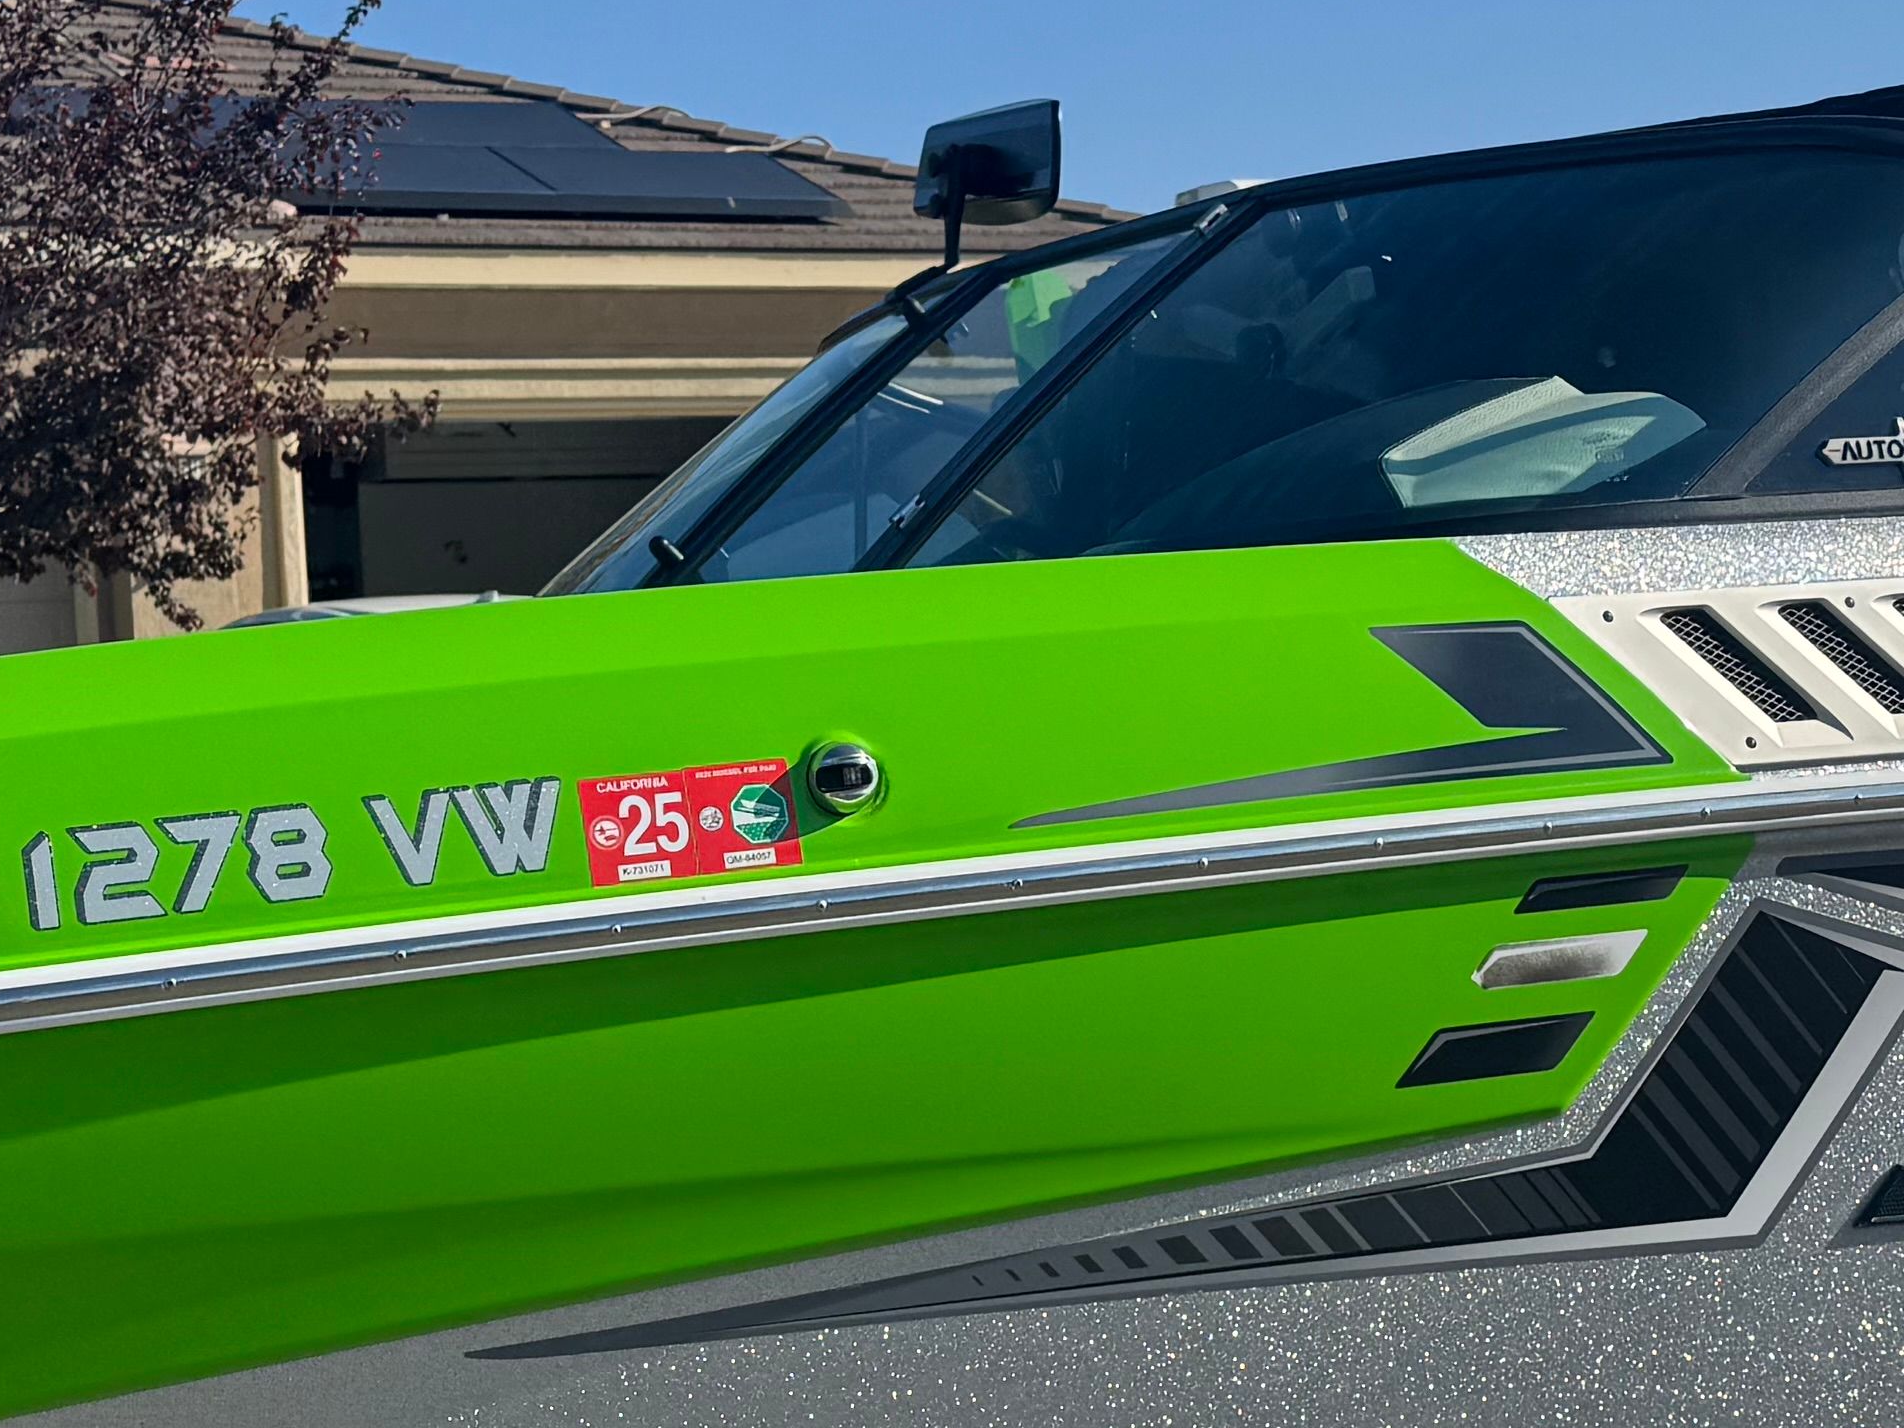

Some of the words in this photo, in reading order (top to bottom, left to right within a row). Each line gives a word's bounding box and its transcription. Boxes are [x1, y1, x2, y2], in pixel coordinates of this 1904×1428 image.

[596, 776, 668, 794] CALIFORNIA
[21, 803, 333, 931] 1278
[362, 775, 561, 886] VW
[618, 791, 690, 857] 25
